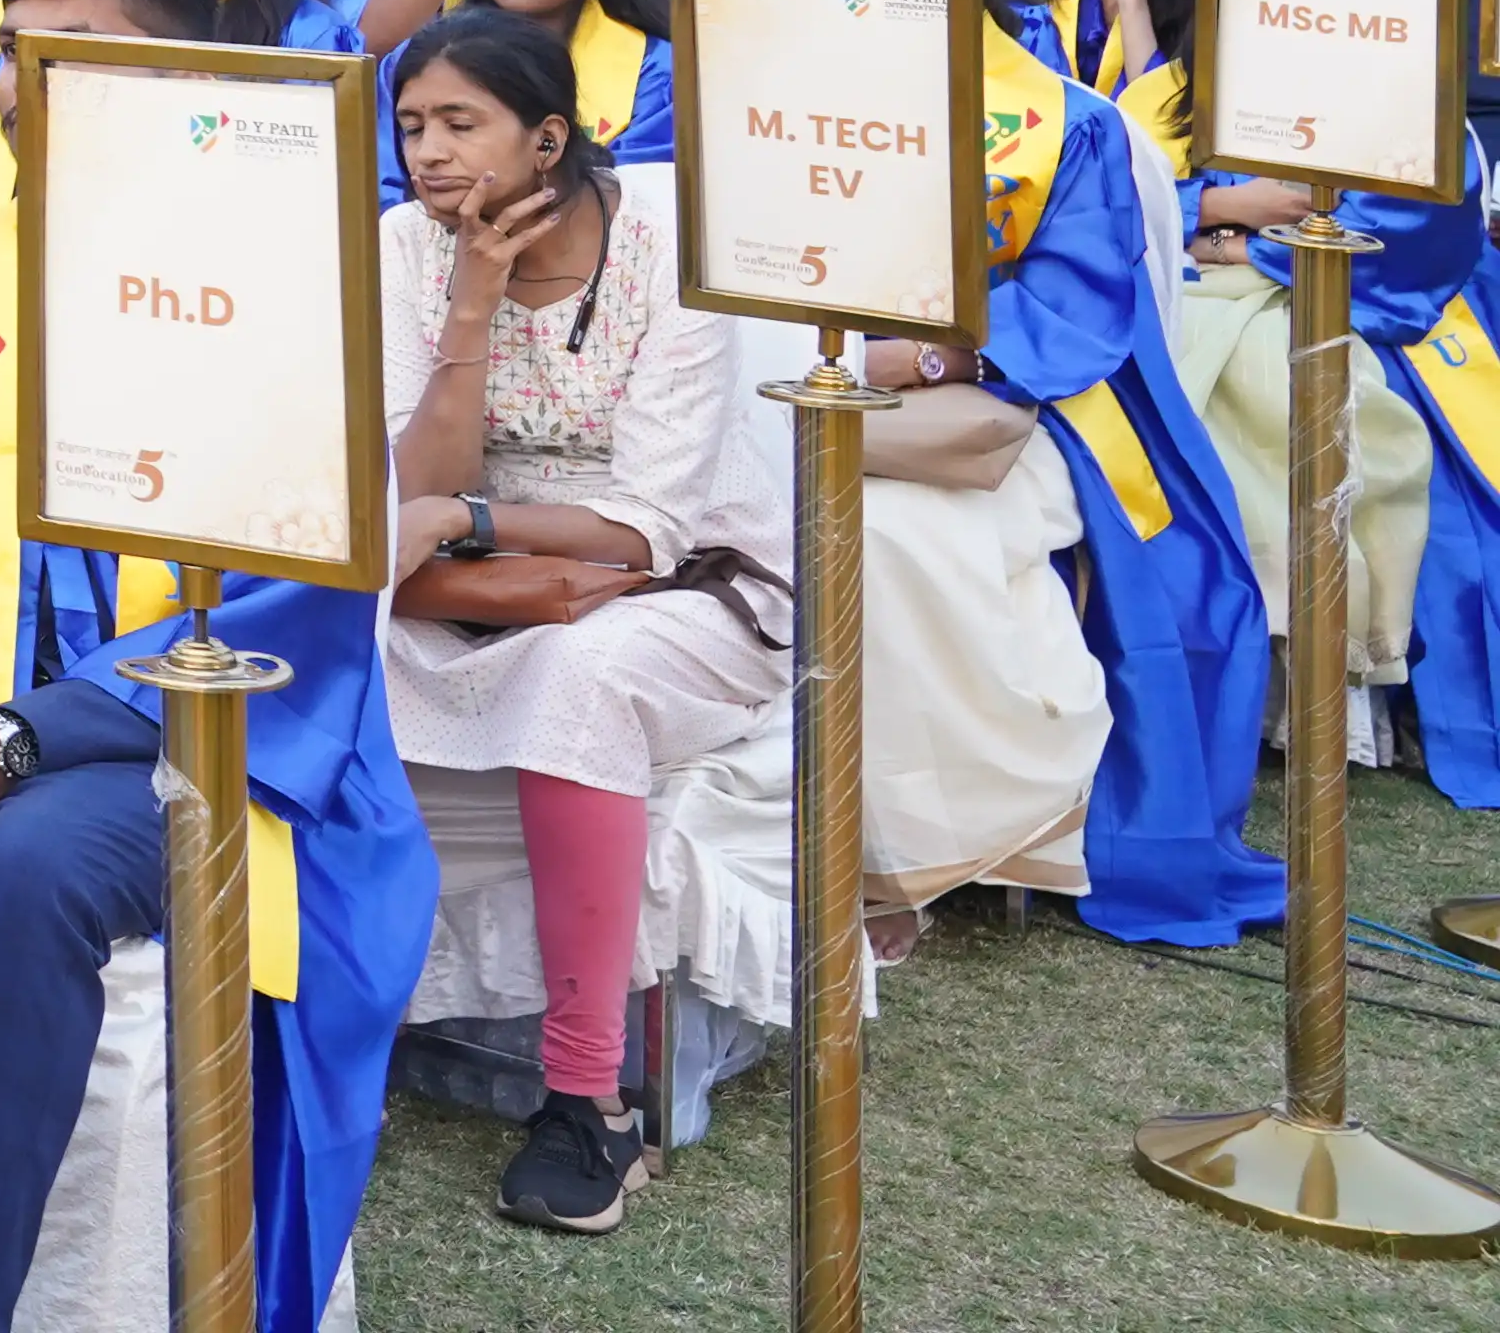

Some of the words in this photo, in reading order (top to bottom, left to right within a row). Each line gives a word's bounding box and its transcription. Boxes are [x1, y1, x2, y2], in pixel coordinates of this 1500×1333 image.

[1258, 0, 1337, 34] MSc
[1347, 12, 1408, 43] MB
[235, 119, 247, 132] D
[253, 121, 264, 133] Y
[269, 122, 319, 138] PATIL
[746, 106, 796, 142] M.
[807, 113, 926, 156] TECH
[1290, 116, 1316, 151] 5
[809, 164, 864, 199] EV
[796, 245, 827, 287] 5
[118, 274, 234, 327] Ph.D
[126, 449, 164, 503] 5
